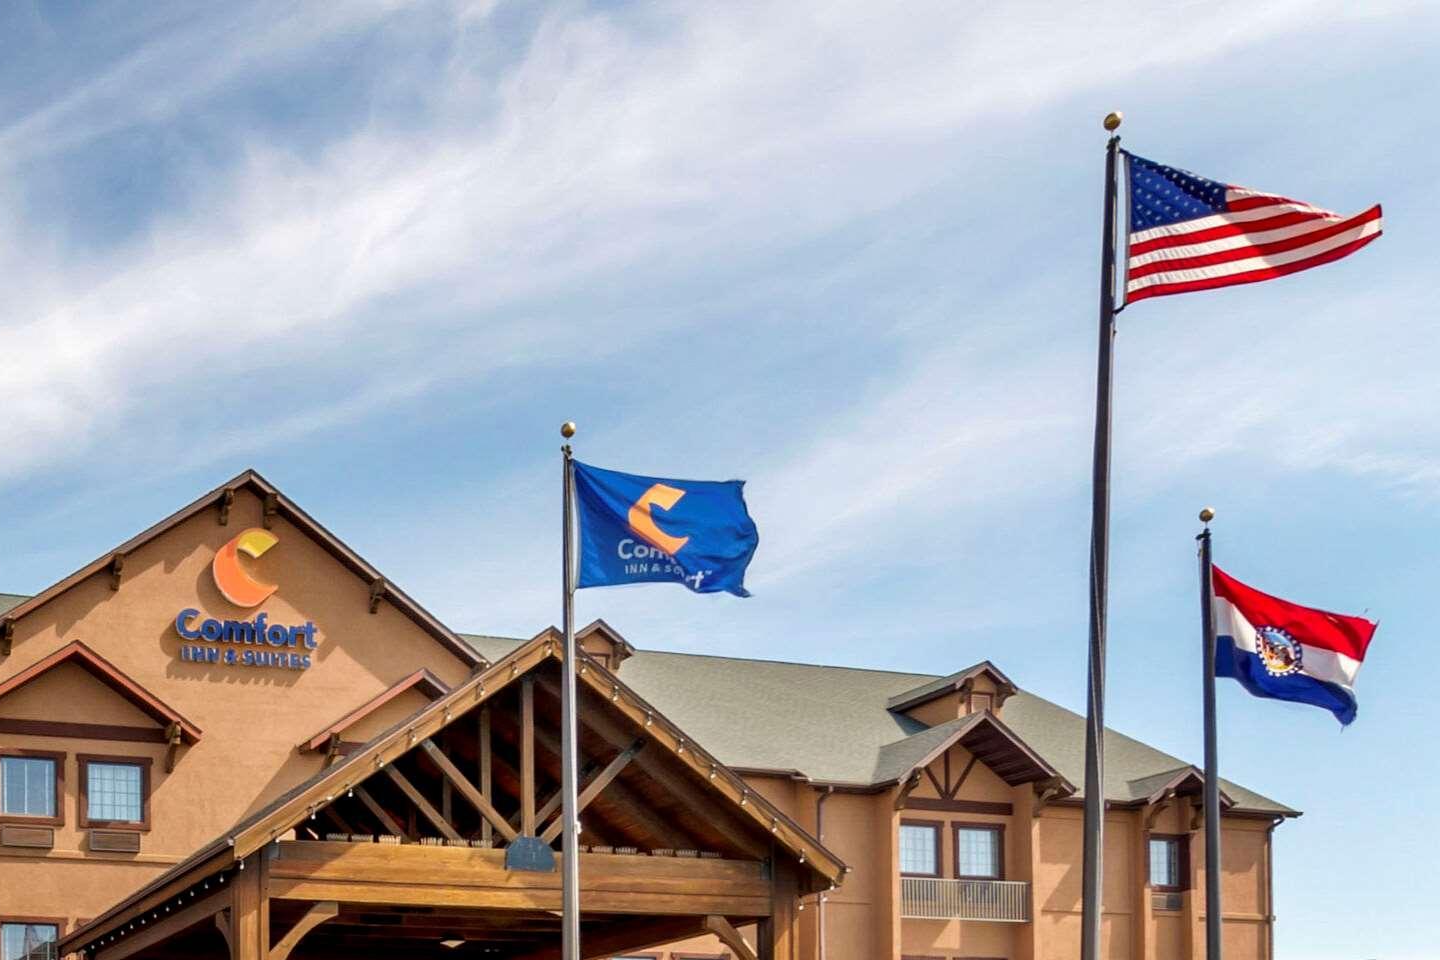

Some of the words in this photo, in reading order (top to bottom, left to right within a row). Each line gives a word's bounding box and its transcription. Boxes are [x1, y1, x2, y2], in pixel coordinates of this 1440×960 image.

[624, 563, 648, 574] INN
[175, 608, 318, 649] Comfort
[181, 645, 220, 663] INN
[224, 648, 238, 665] &
[242, 649, 312, 669] SUITES
